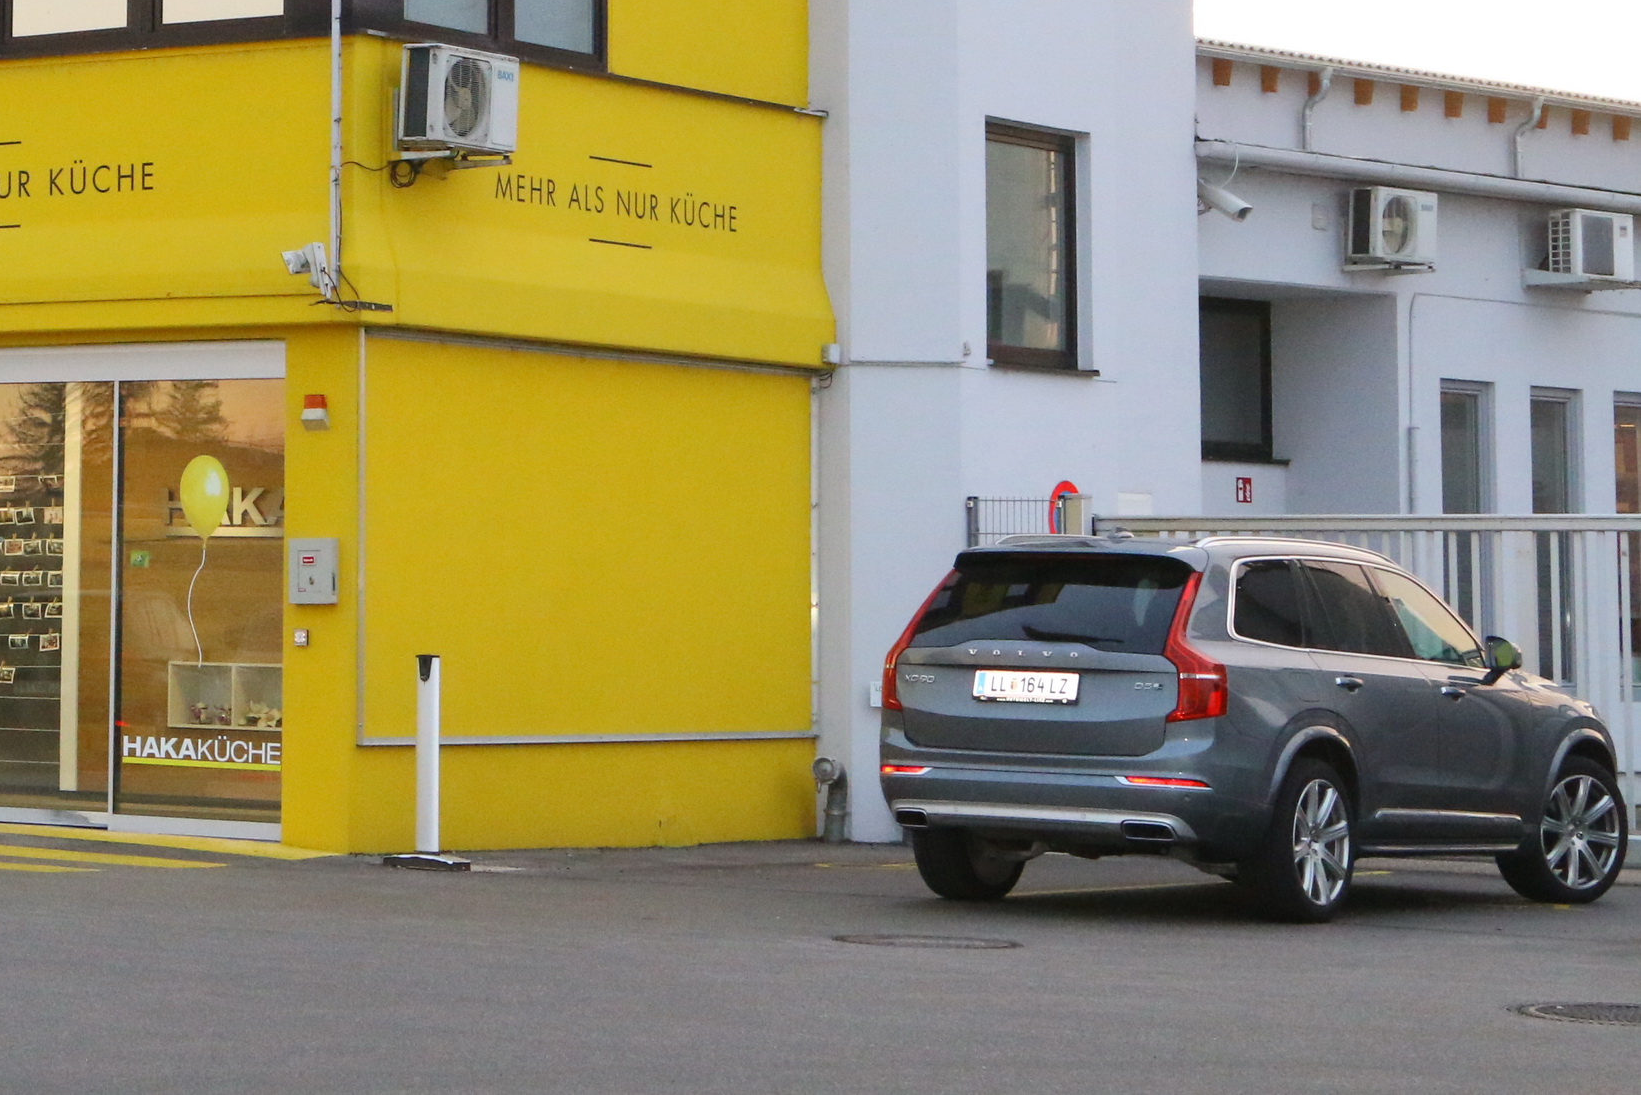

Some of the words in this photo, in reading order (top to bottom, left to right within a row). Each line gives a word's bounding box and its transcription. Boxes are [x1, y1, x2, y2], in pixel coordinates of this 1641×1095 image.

[49, 159, 154, 196] KÜCHE
[495, 173, 556, 207] MEHR
[568, 184, 604, 214] ALS
[616, 190, 659, 221] NUR
[670, 192, 738, 233] KÜCHE
[968, 648, 1079, 658] VOLVO
[991, 675, 1006, 692] LL
[1020, 677, 1045, 693] 164
[1049, 679, 1068, 694] LZ
[123, 735, 281, 765] HAKAKÜCHE
